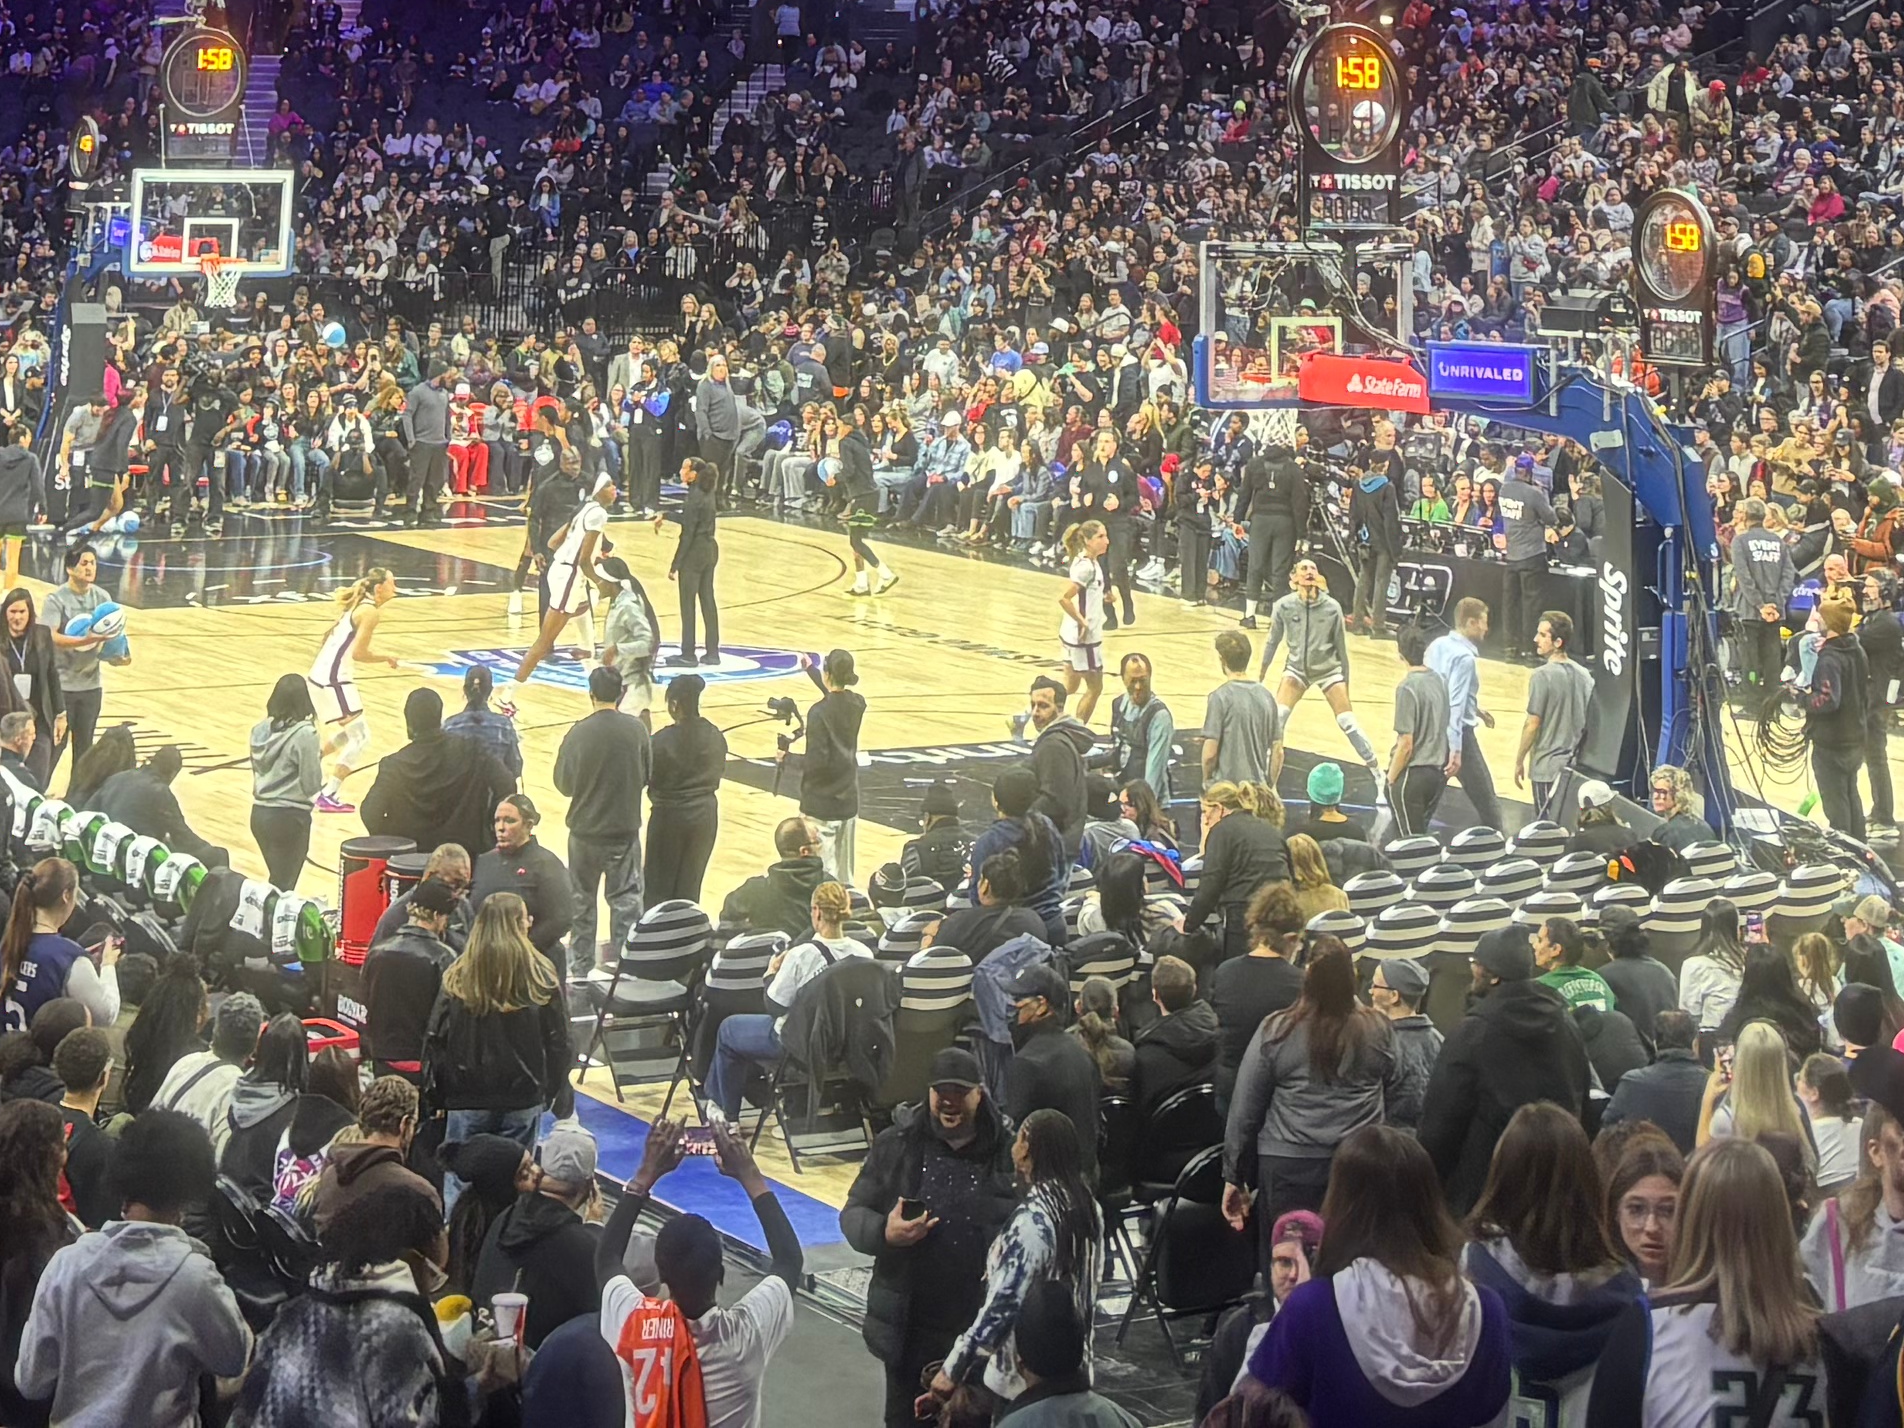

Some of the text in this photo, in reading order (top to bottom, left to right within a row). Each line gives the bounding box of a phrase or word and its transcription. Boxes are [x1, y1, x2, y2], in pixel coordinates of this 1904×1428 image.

[197, 48, 233, 71] 1:58
[1336, 56, 1380, 89] 1:58
[186, 123, 234, 134] TISSOT
[1334, 174, 1396, 191] TISSOT
[1665, 223, 1699, 251] 1:58
[1658, 308, 1702, 324] TISSOT
[1438, 361, 1523, 381] UNRIVALED
[1748, 540, 1780, 552] EVENT
[1752, 551, 1780, 563] STAFF
[1604, 561, 1628, 676] Sprite
